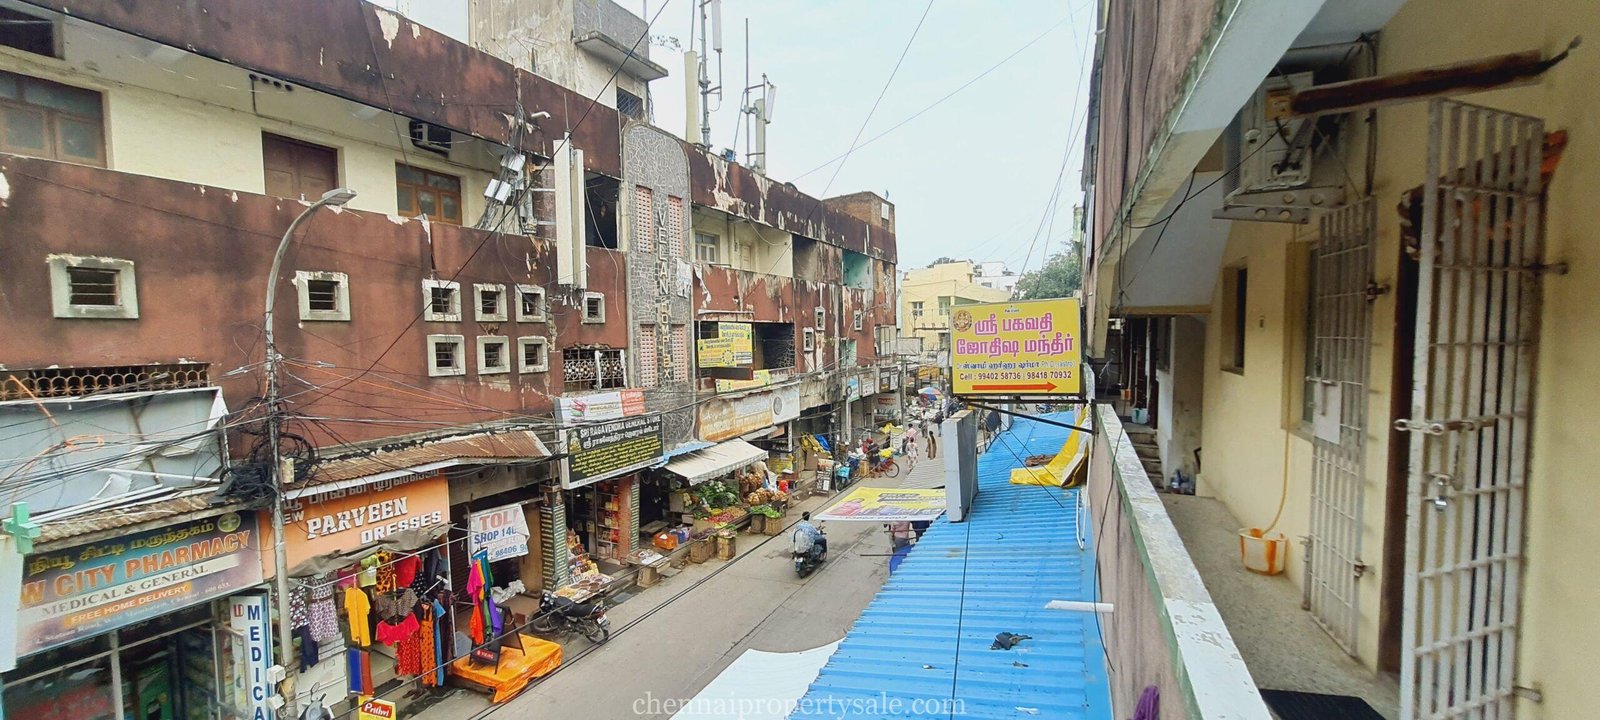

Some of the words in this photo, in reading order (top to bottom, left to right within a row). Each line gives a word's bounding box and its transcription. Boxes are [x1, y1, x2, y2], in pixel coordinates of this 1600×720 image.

[658, 210, 669, 295] VELAN
[1002, 312, 1052, 335] பகவதி
[956, 337, 1019, 358] ஜோதிஷ
[960, 372, 973, 381] Cell
[977, 372, 999, 380] 99402
[1000, 371, 1021, 380] 58736
[1027, 371, 1048, 379] 98418
[1050, 370, 1072, 379] 70932
[306, 497, 408, 540] PARVEEN
[361, 510, 442, 544] DRESSES
[474, 530, 499, 544] SHOP
[53, 563, 117, 598] CITY
[124, 530, 251, 579] PHARMACY
[41, 589, 122, 617] MEDICAL
[124, 582, 137, 595] &
[140, 564, 209, 590] GENERAL
[71, 611, 101, 625] FREE
[104, 599, 136, 618] HOME
[138, 584, 190, 608] DELIVERY
